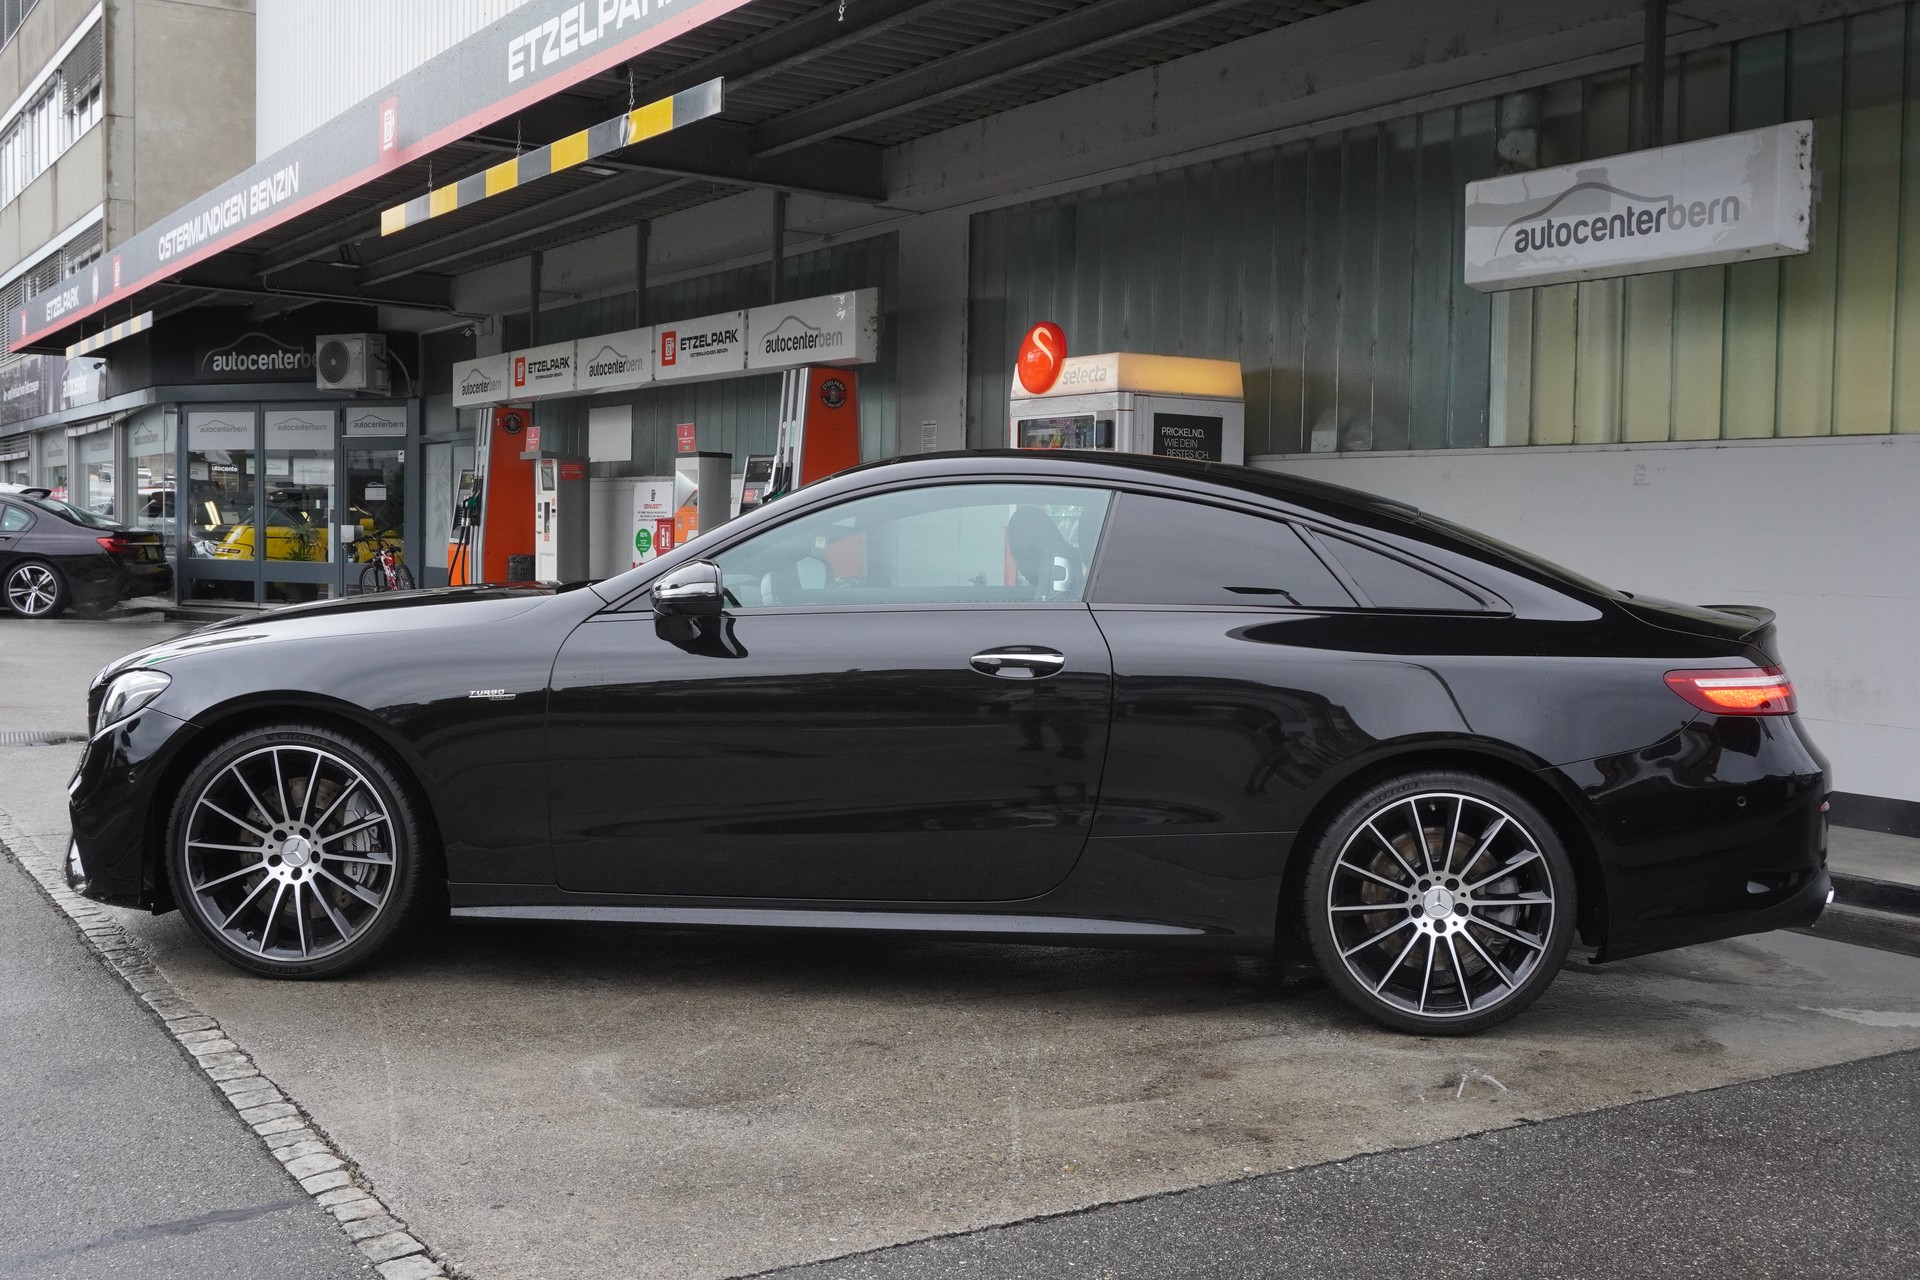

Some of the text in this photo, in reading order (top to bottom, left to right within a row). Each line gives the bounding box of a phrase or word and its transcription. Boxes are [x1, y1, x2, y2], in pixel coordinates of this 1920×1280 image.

[508, 0, 679, 83] ETZELPA
[158, 161, 299, 261] OSTERMUNDIGEN BENZIN
[1514, 195, 1740, 253] autocenterbern
[46, 285, 80, 322] ETZELPARK
[680, 329, 738, 351] ETZELPARK
[765, 331, 843, 354] autocenterbern
[212, 349, 317, 371] autocenterbe
[527, 356, 570, 374] ETZELPARK
[588, 357, 643, 378] autocenterbern
[1062, 365, 1107, 385] selecta
[461, 379, 502, 396] autocenterbern
[199, 424, 248, 434] autocenterbern
[276, 422, 327, 432] autocenterbern
[353, 419, 405, 429] autocenterbern
[1162, 426, 1205, 438] PRICKELND,
[1164, 437, 1197, 448] WIE DEIN
[1166, 448, 1194, 459] BESTES
[753, 489, 759, 500] 2
[468, 688, 505, 696] TURBO
